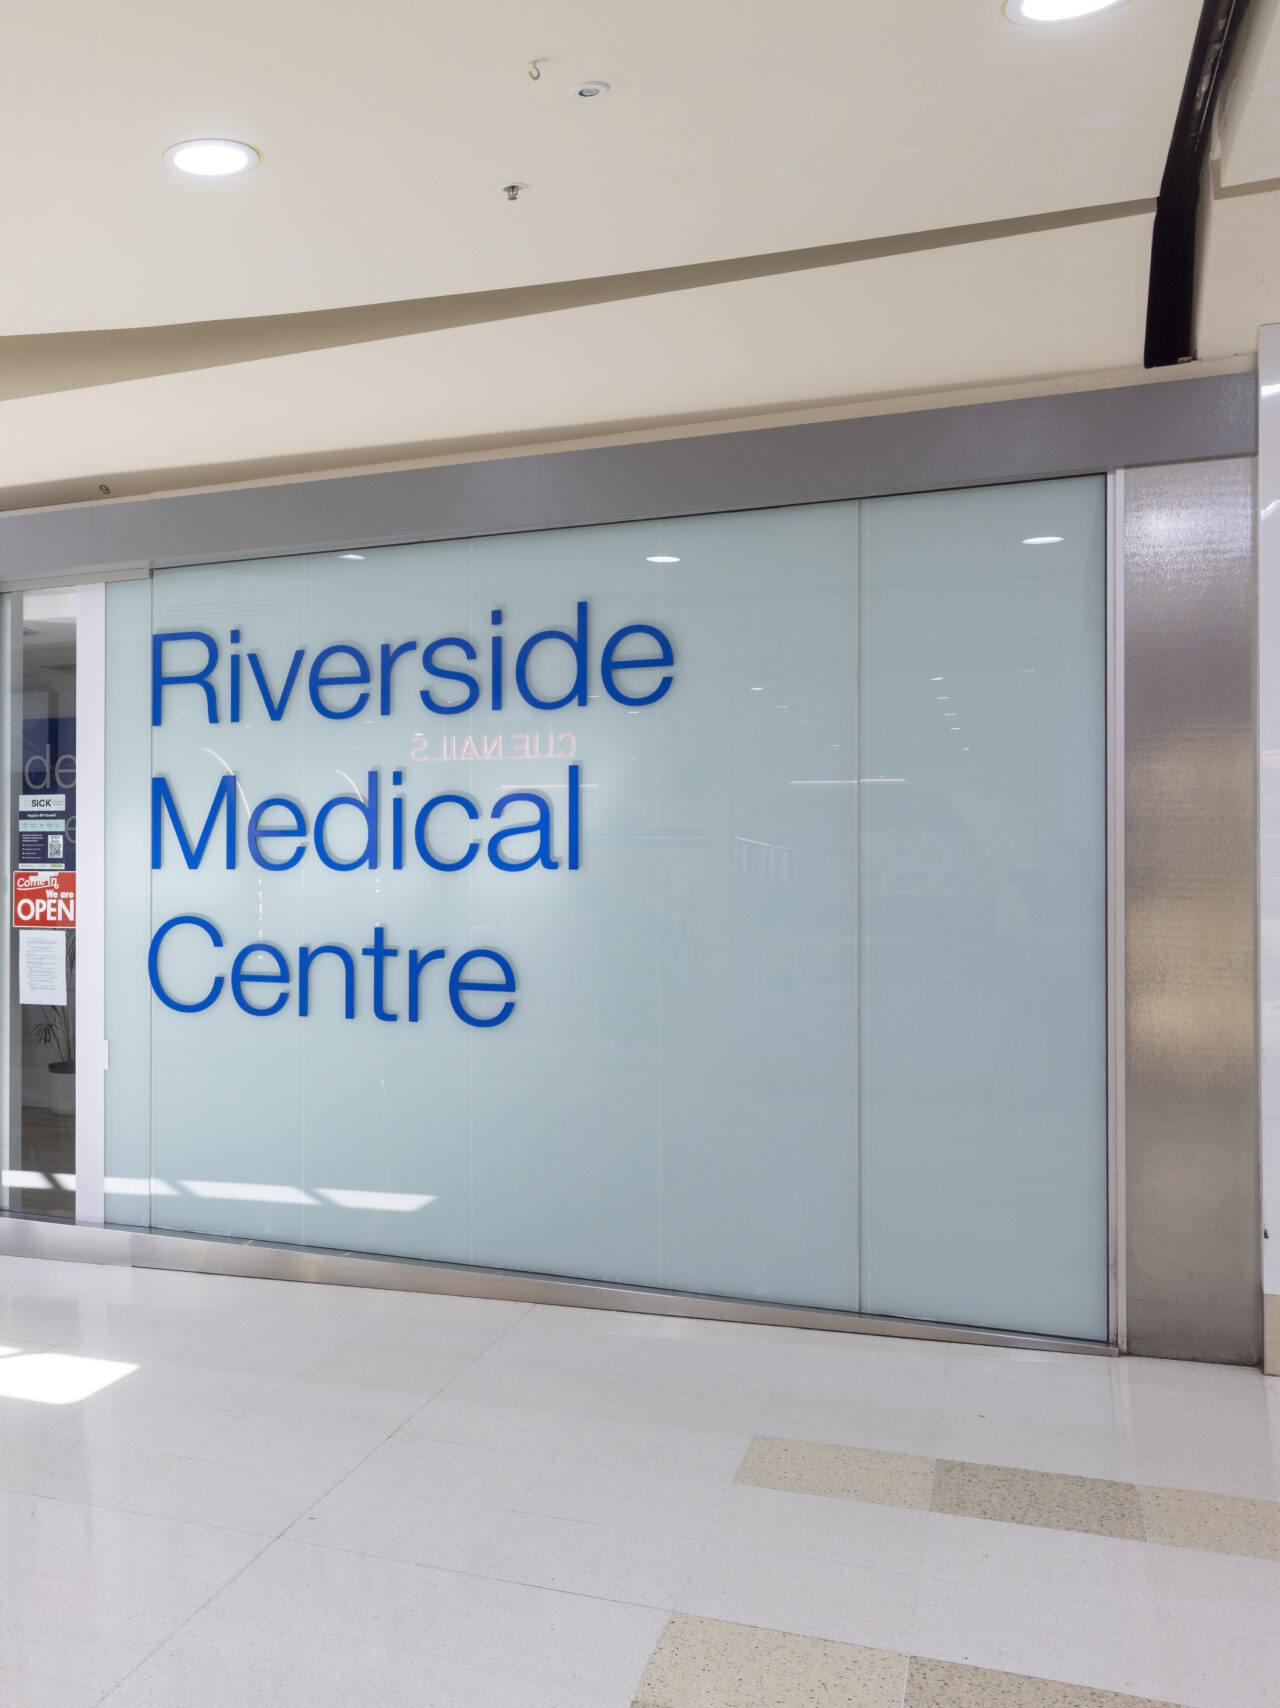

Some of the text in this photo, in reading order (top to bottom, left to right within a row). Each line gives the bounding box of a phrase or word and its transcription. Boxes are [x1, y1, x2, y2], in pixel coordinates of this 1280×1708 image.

[152, 601, 674, 727] Riverside
[152, 765, 580, 872] Medical
[17, 898, 74, 921] OPEN
[45, 889, 58, 898] We
[148, 916, 517, 1028] Centre
